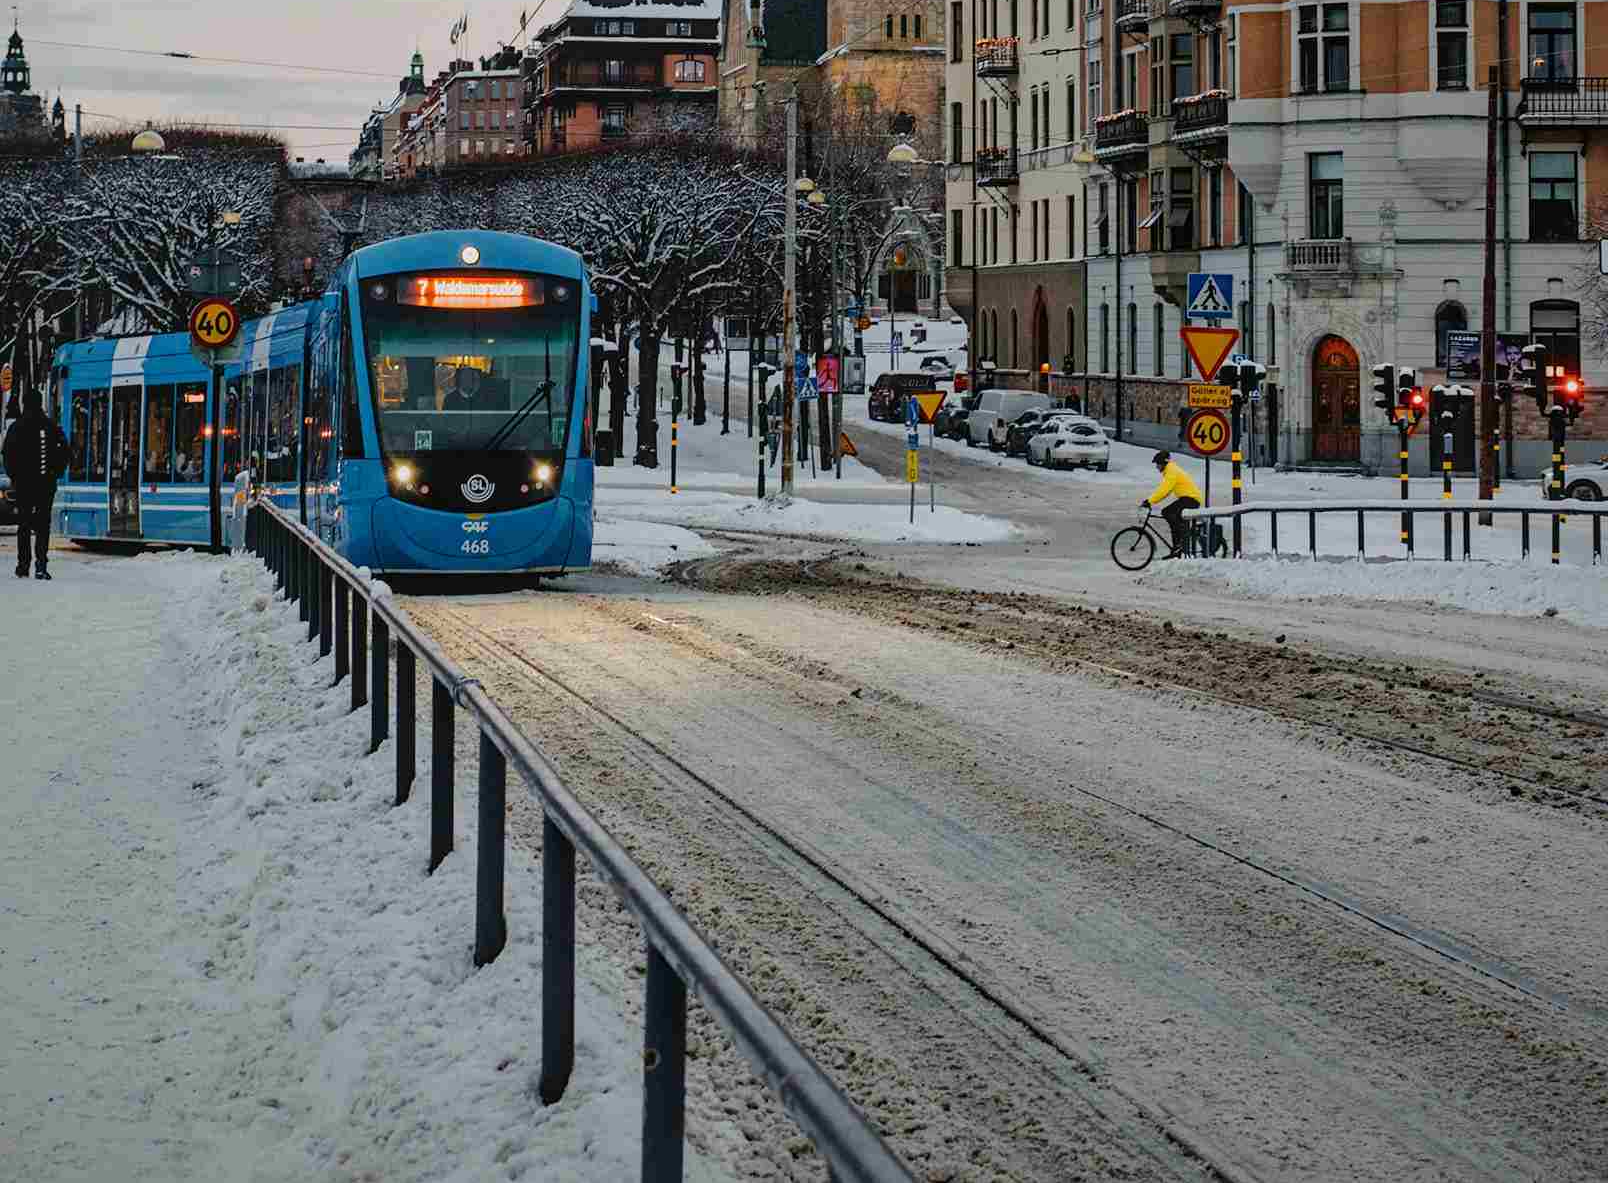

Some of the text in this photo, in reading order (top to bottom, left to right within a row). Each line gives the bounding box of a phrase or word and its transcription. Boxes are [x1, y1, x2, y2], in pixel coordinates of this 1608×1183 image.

[416, 279, 429, 296] 7
[197, 310, 231, 336] 40
[1193, 422, 1224, 444] 40
[470, 478, 486, 491] SL
[461, 539, 489, 554] 468
